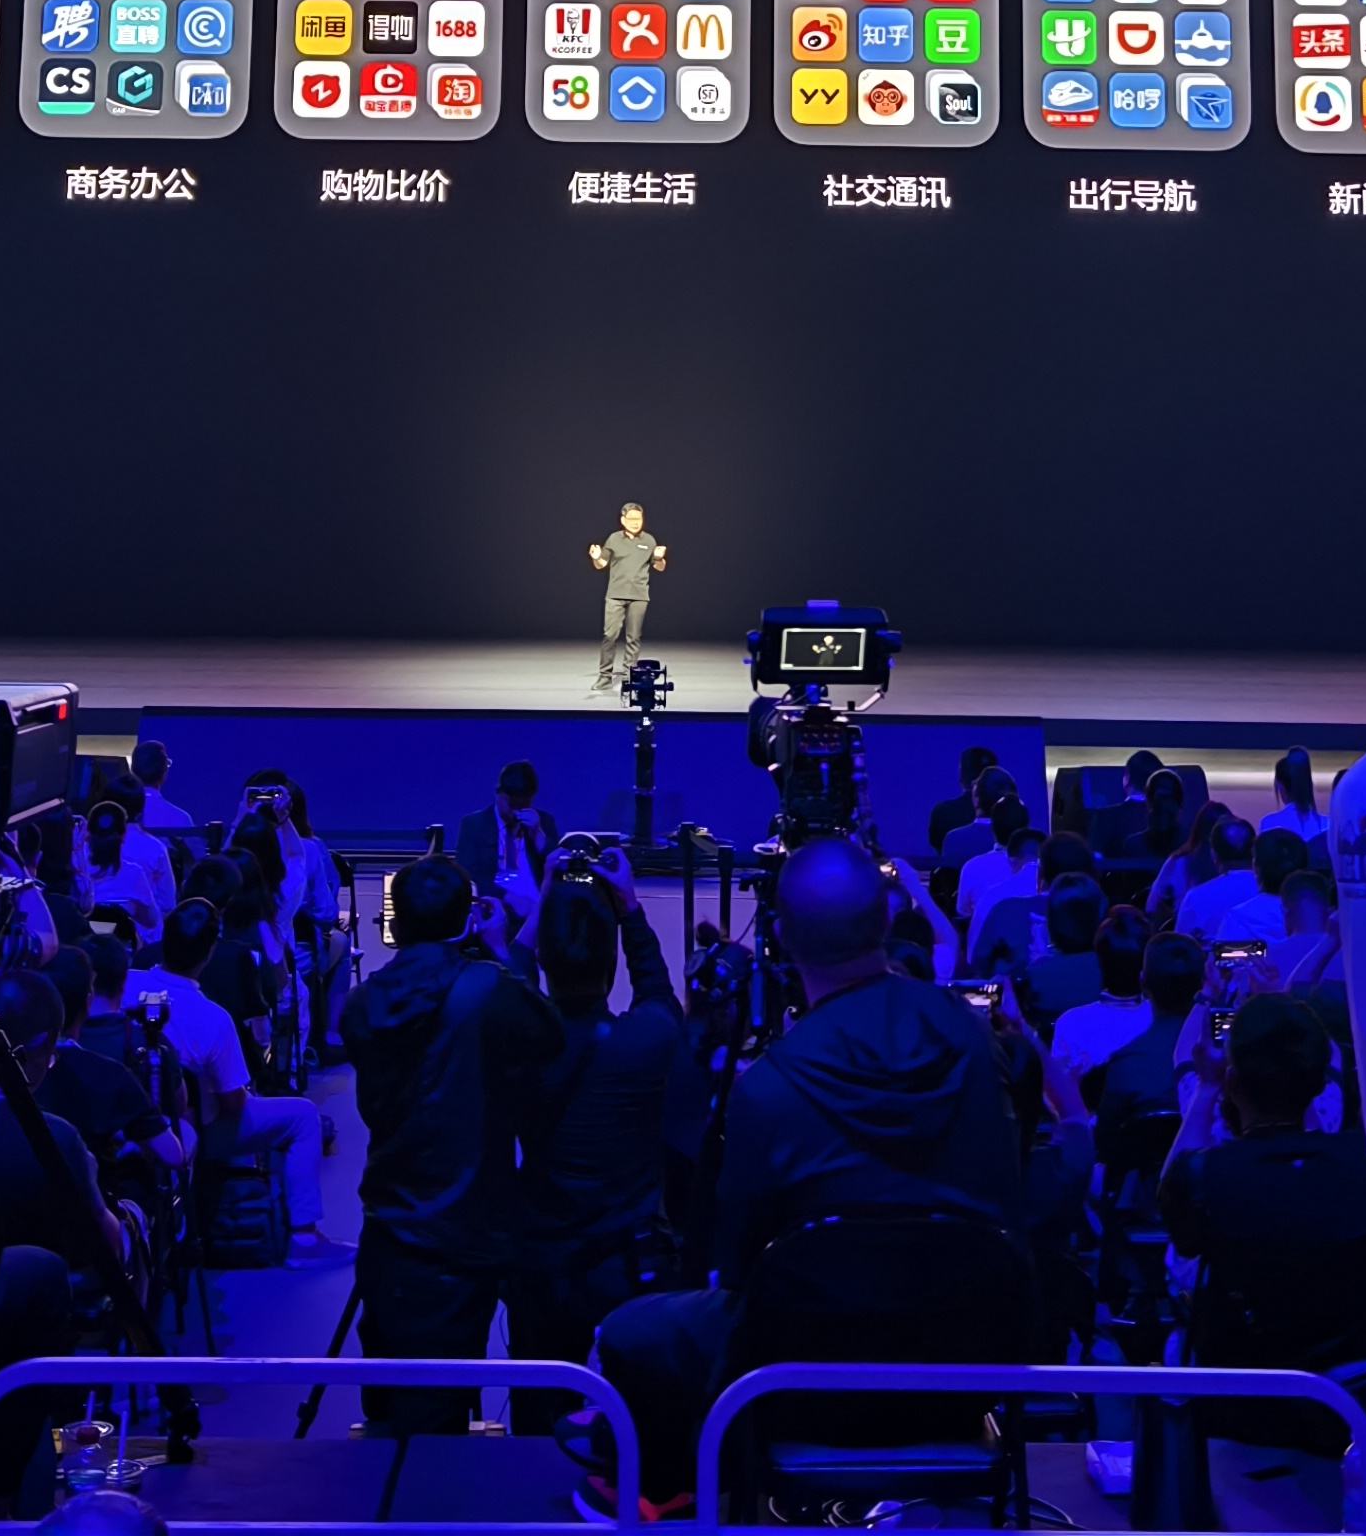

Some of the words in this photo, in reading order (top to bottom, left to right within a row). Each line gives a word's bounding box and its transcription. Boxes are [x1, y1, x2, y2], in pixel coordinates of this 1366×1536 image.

[42, 0, 95, 48] 聘
[117, 6, 161, 20] BOSS
[115, 26, 159, 45] 直聘
[301, 16, 346, 38] 闲鱼
[368, 15, 413, 41] 得物
[435, 20, 477, 37] 1688
[562, 35, 583, 43] KFC
[863, 24, 909, 47] 知乎
[936, 19, 969, 52] 豆
[552, 46, 592, 54] KCOFFEE
[1299, 28, 1345, 54] 头条
[46, 66, 91, 94] CS
[445, 79, 475, 103] 淘
[192, 83, 225, 106] CAD
[553, 76, 590, 110] 58
[945, 95, 973, 112] Soul
[1114, 88, 1161, 111] 哈啰
[65, 166, 197, 200] 商务办公
[319, 168, 451, 202] 购物比价
[568, 171, 696, 205] 便捷生活
[823, 174, 951, 208] 社交通讯
[1069, 178, 1197, 212] 出行导航
